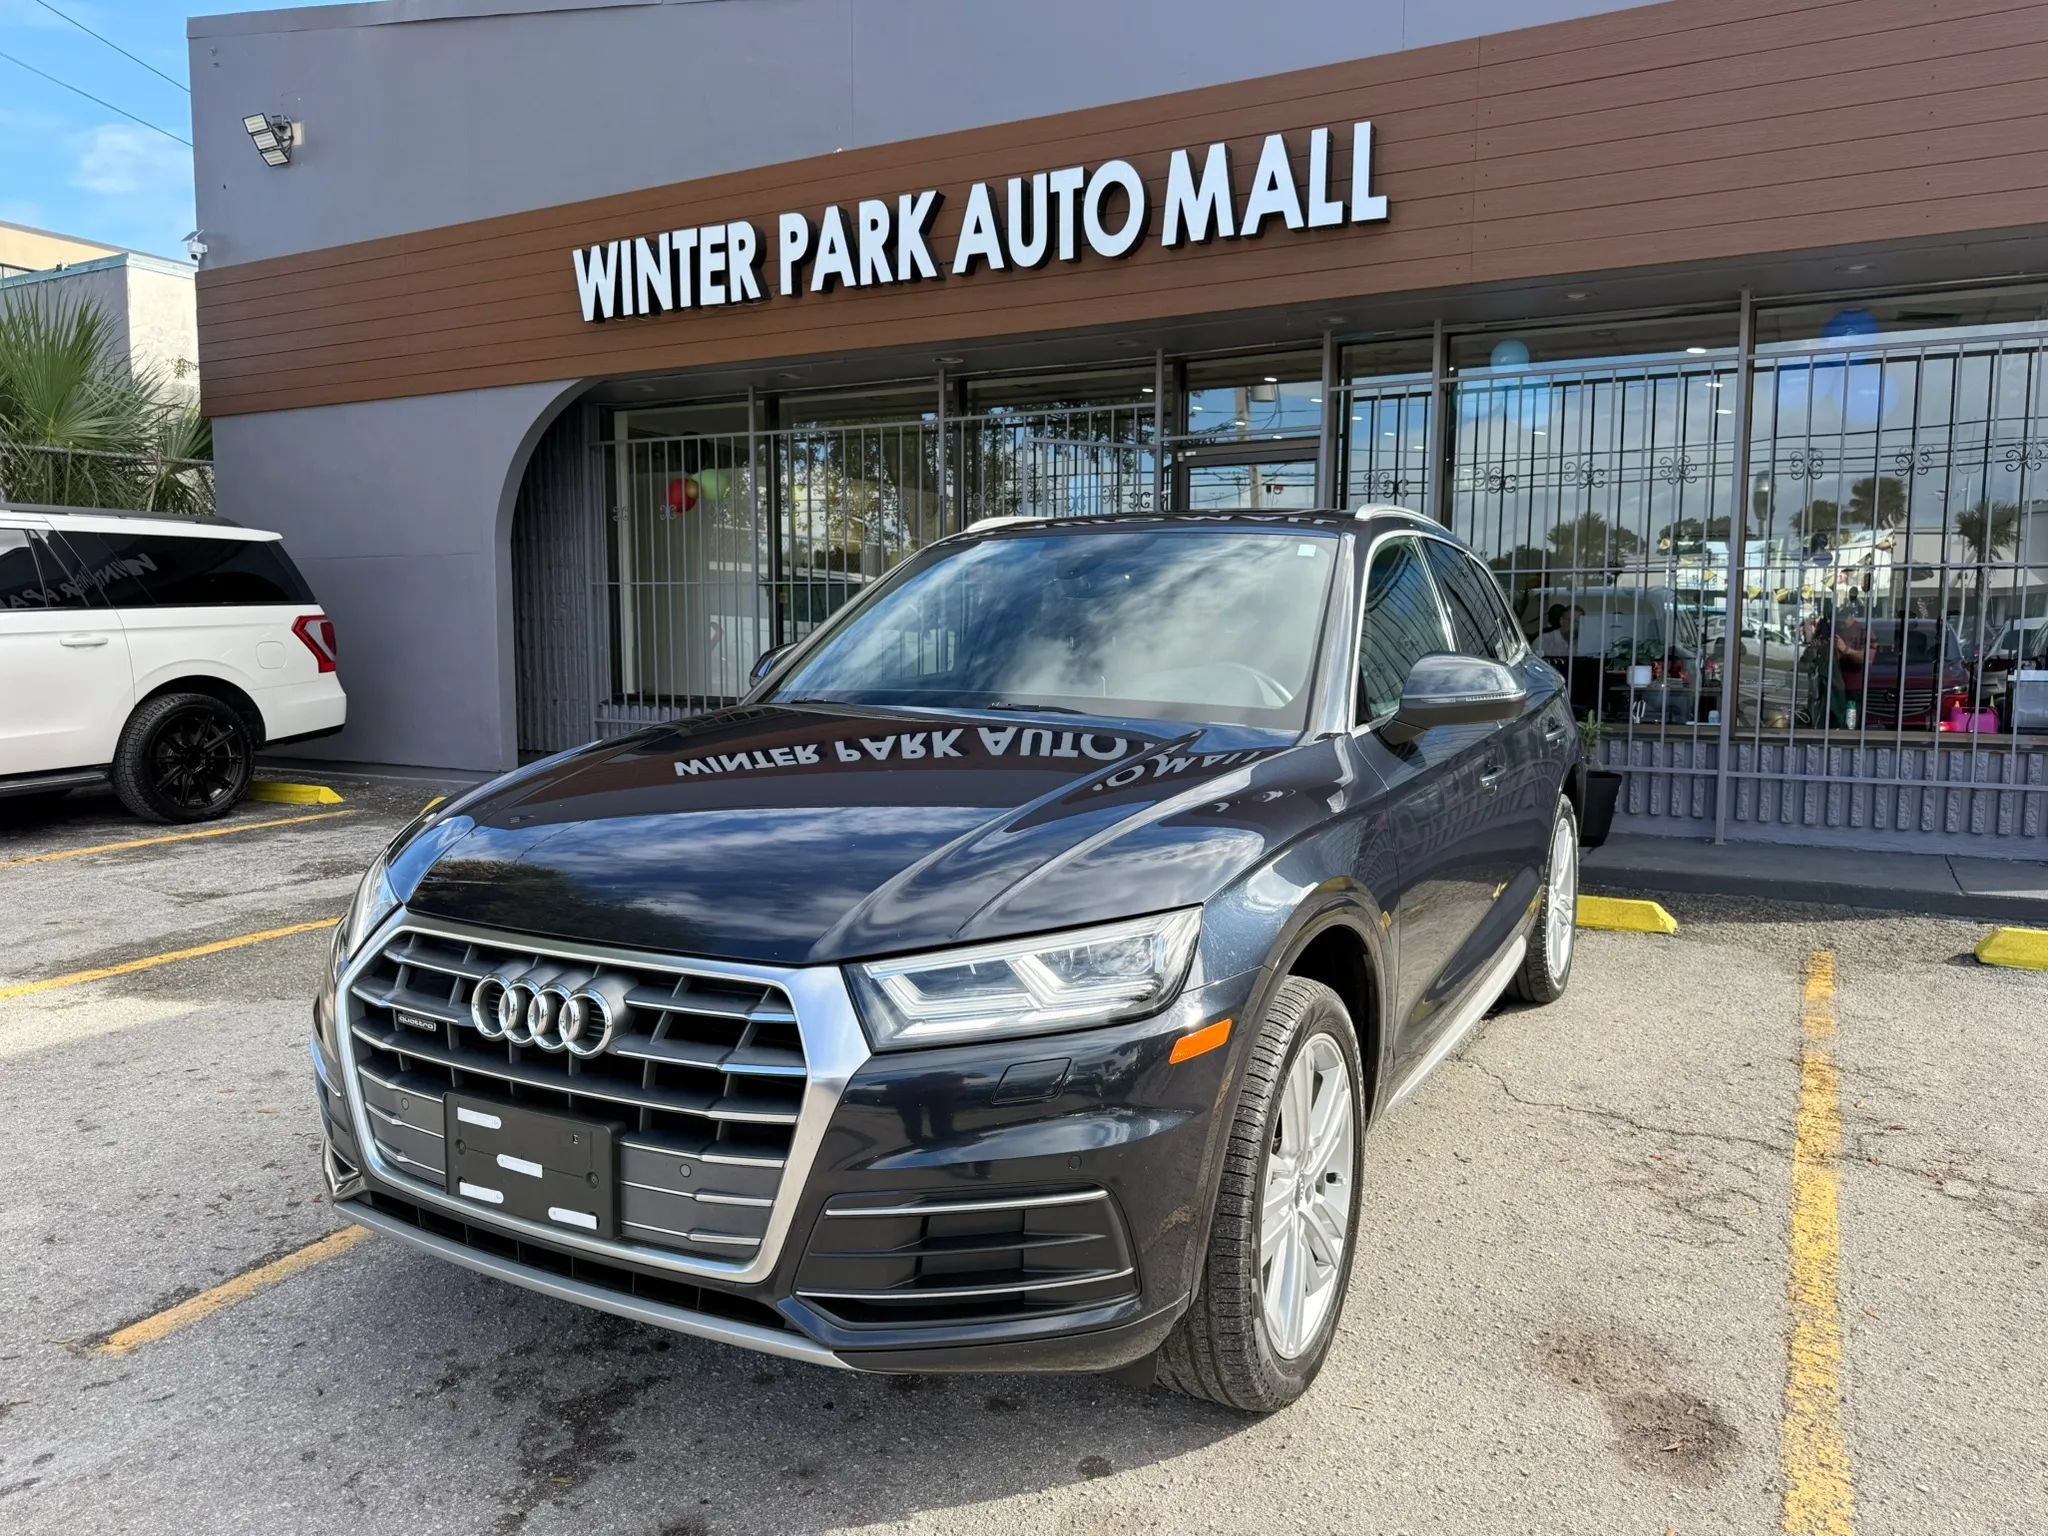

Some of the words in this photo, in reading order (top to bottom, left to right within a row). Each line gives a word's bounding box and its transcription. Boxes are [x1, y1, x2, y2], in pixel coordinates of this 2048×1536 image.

[572, 221, 761, 322] WINTER
[779, 190, 938, 296] PARK
[952, 159, 1145, 274] AUTO
[1162, 121, 1388, 247] MALL
[399, 1015, 434, 1029] quattro
